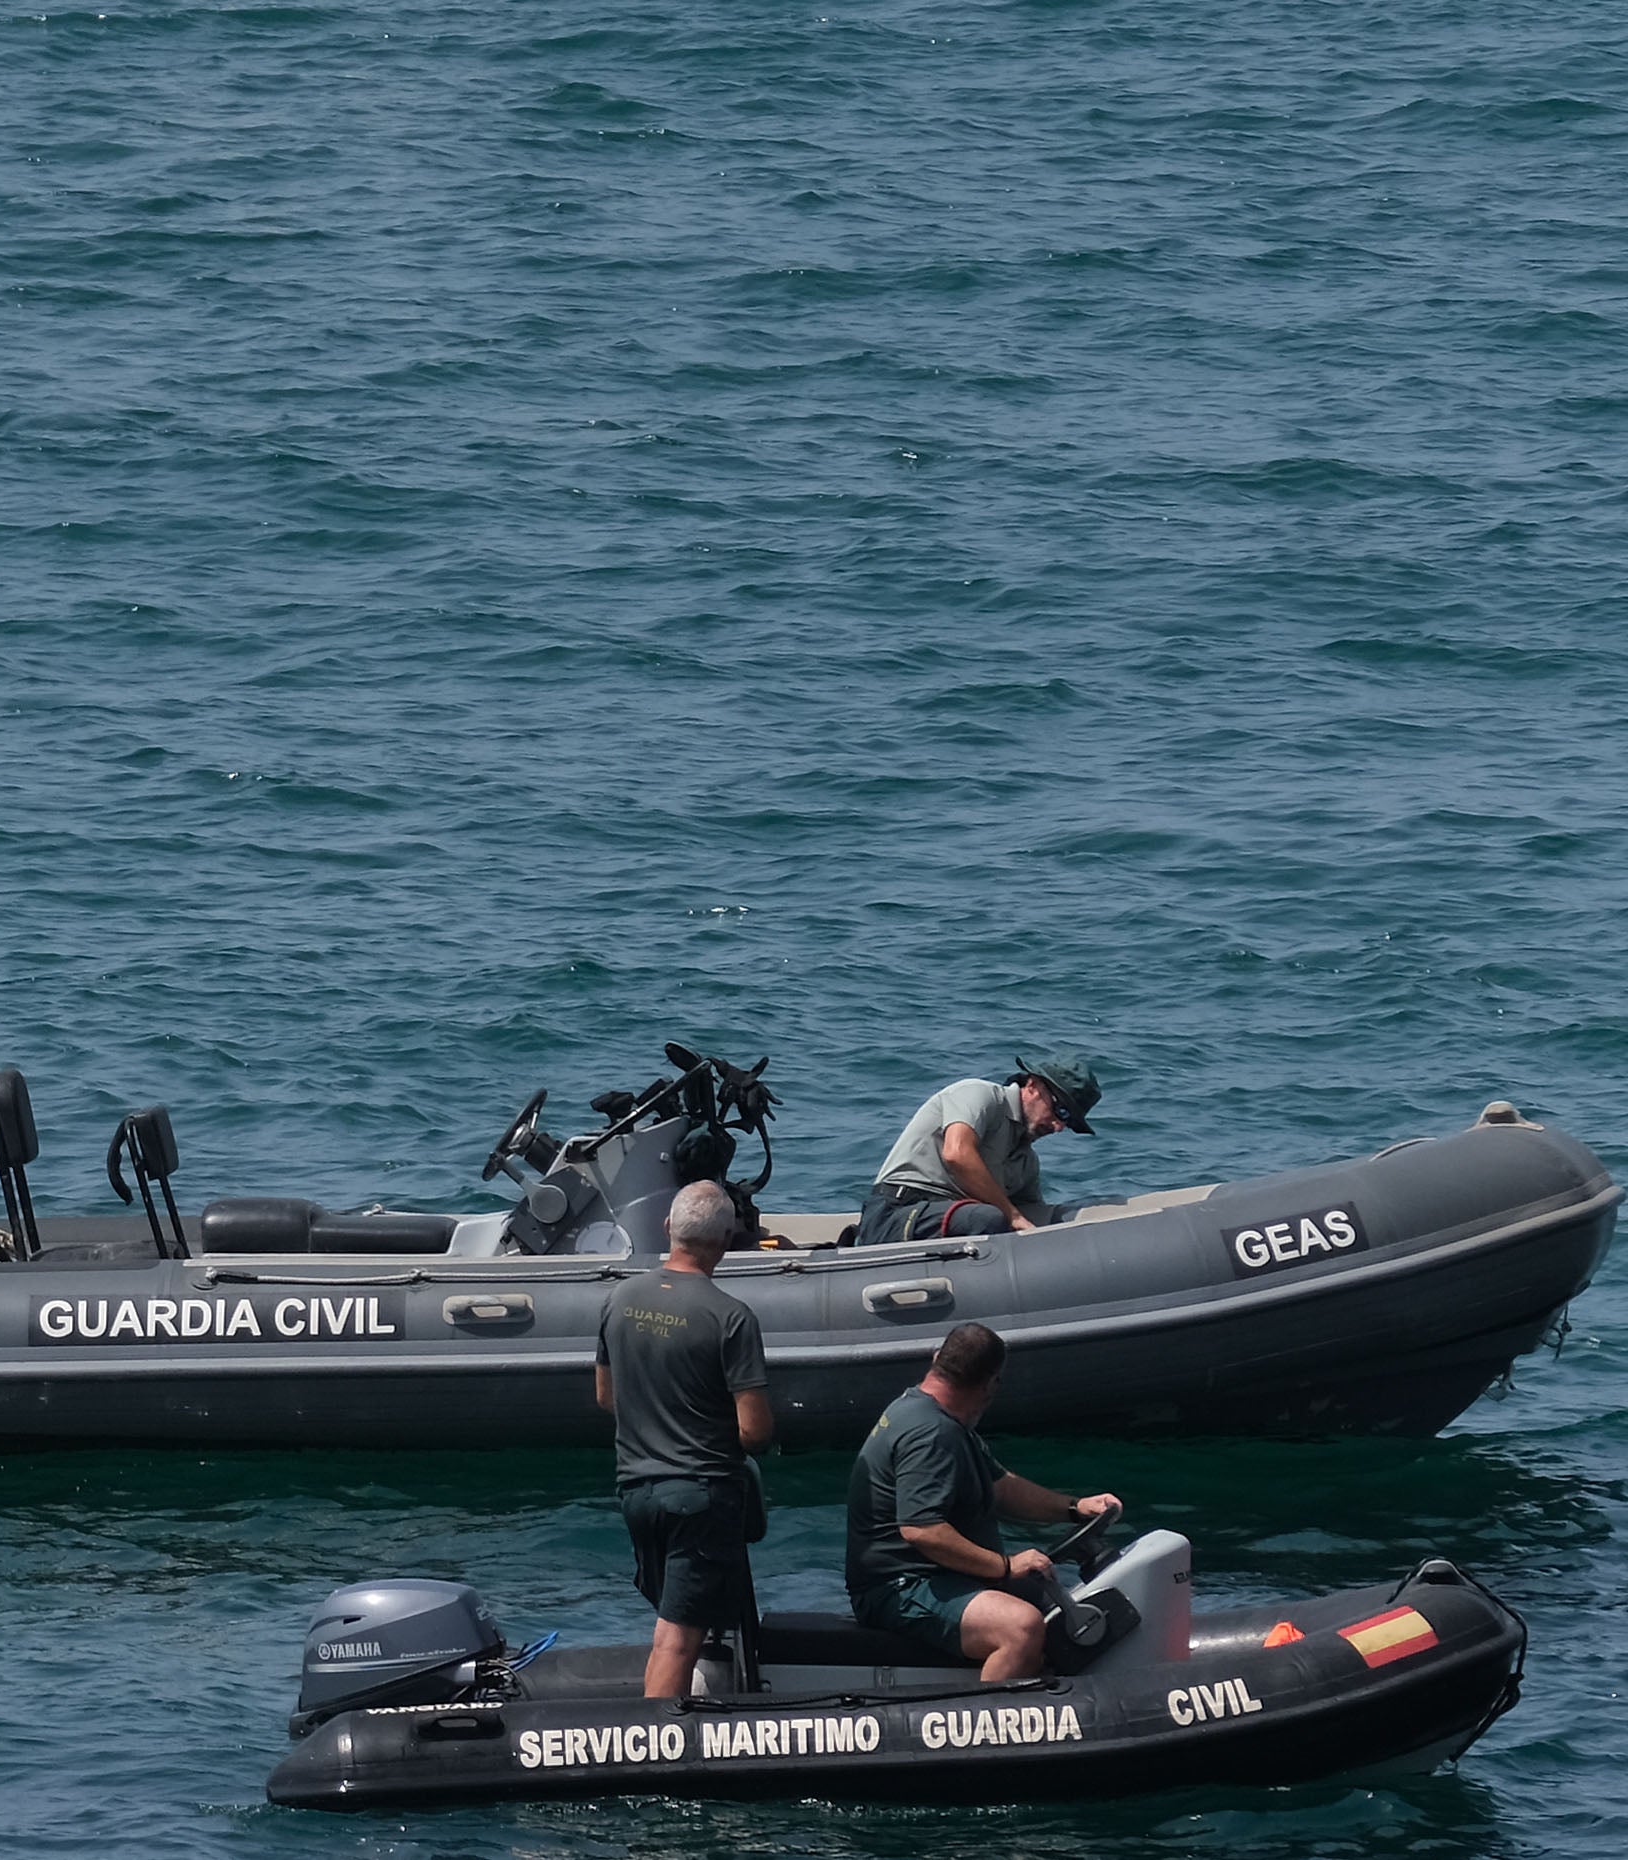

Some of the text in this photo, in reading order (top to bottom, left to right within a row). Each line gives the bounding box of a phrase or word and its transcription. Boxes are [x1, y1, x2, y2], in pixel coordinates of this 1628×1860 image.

[1235, 1210, 1357, 1268] GEAS
[39, 1297, 395, 1338] GUARDIA CIVIL
[624, 1306, 689, 1329] GUARDIA
[635, 1321, 671, 1338] CVIL
[330, 1641, 382, 1659] YAMAHA
[518, 1677, 1263, 1769] SERVICIO MARITIMO GUARDIA CIVIL
